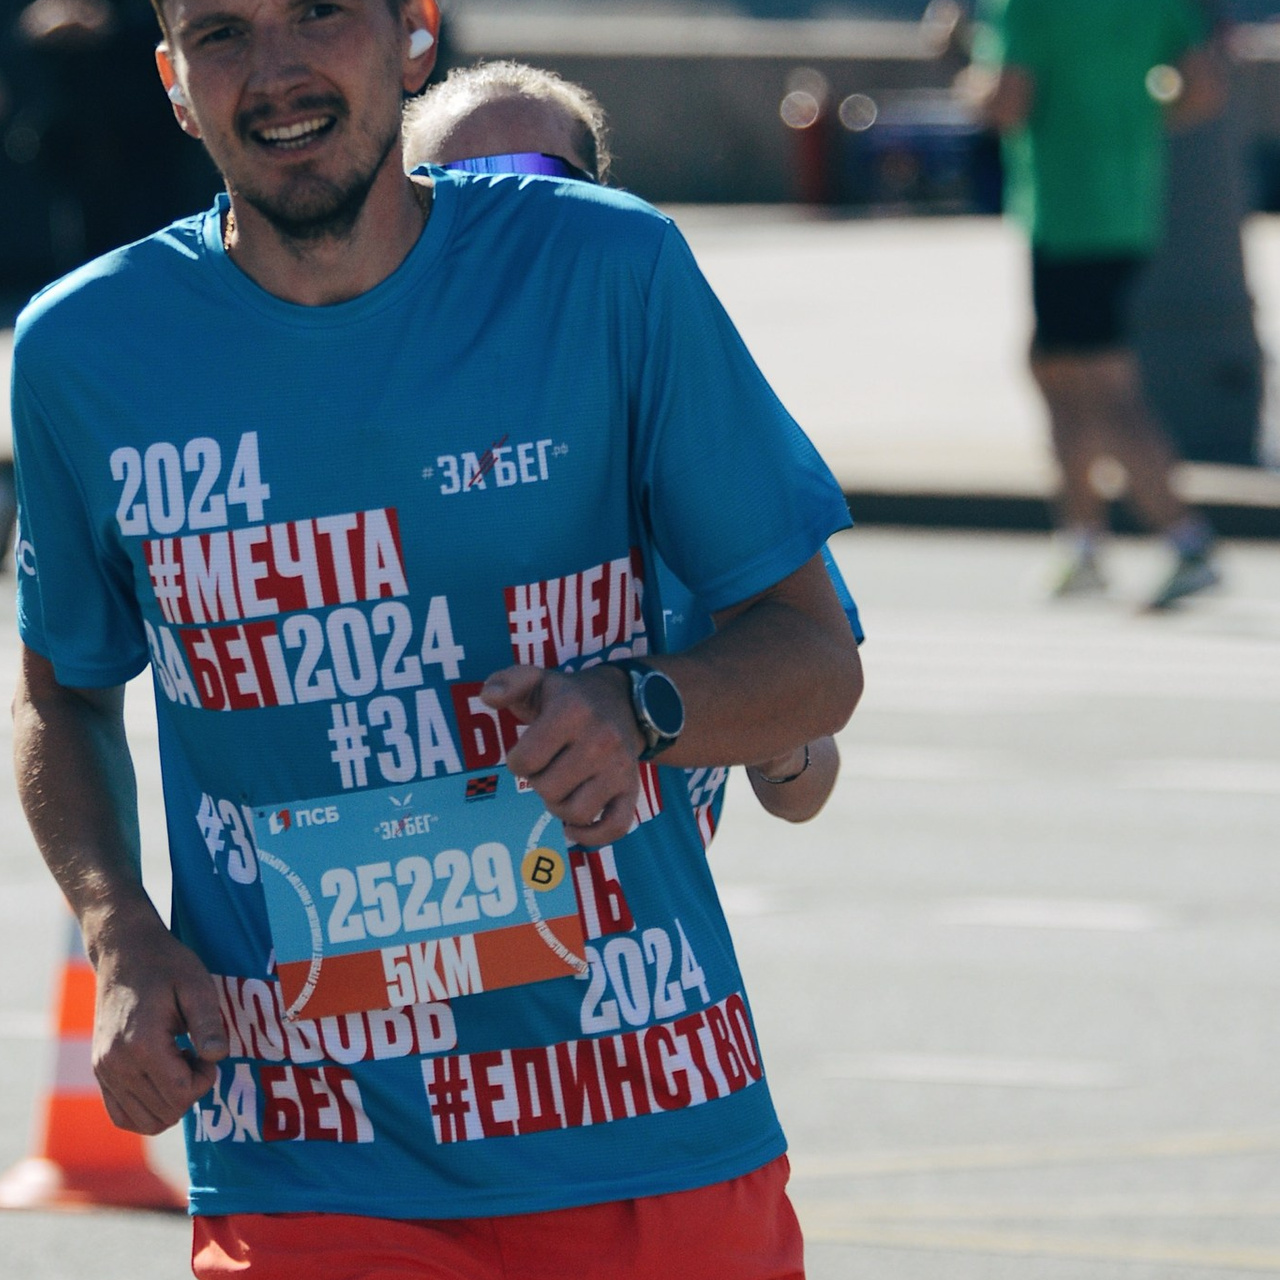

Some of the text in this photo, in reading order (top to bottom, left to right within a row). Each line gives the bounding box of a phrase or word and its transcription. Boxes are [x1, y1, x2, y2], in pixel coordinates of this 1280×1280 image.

[109, 431, 271, 536] 2024
[148, 507, 409, 624] #МЕЧТА
[295, 805, 340, 828] ПСБ
[320, 841, 518, 944] 25229
[580, 918, 710, 1035] 2024
[428, 994, 763, 1144] #ЕДИНСТВО
